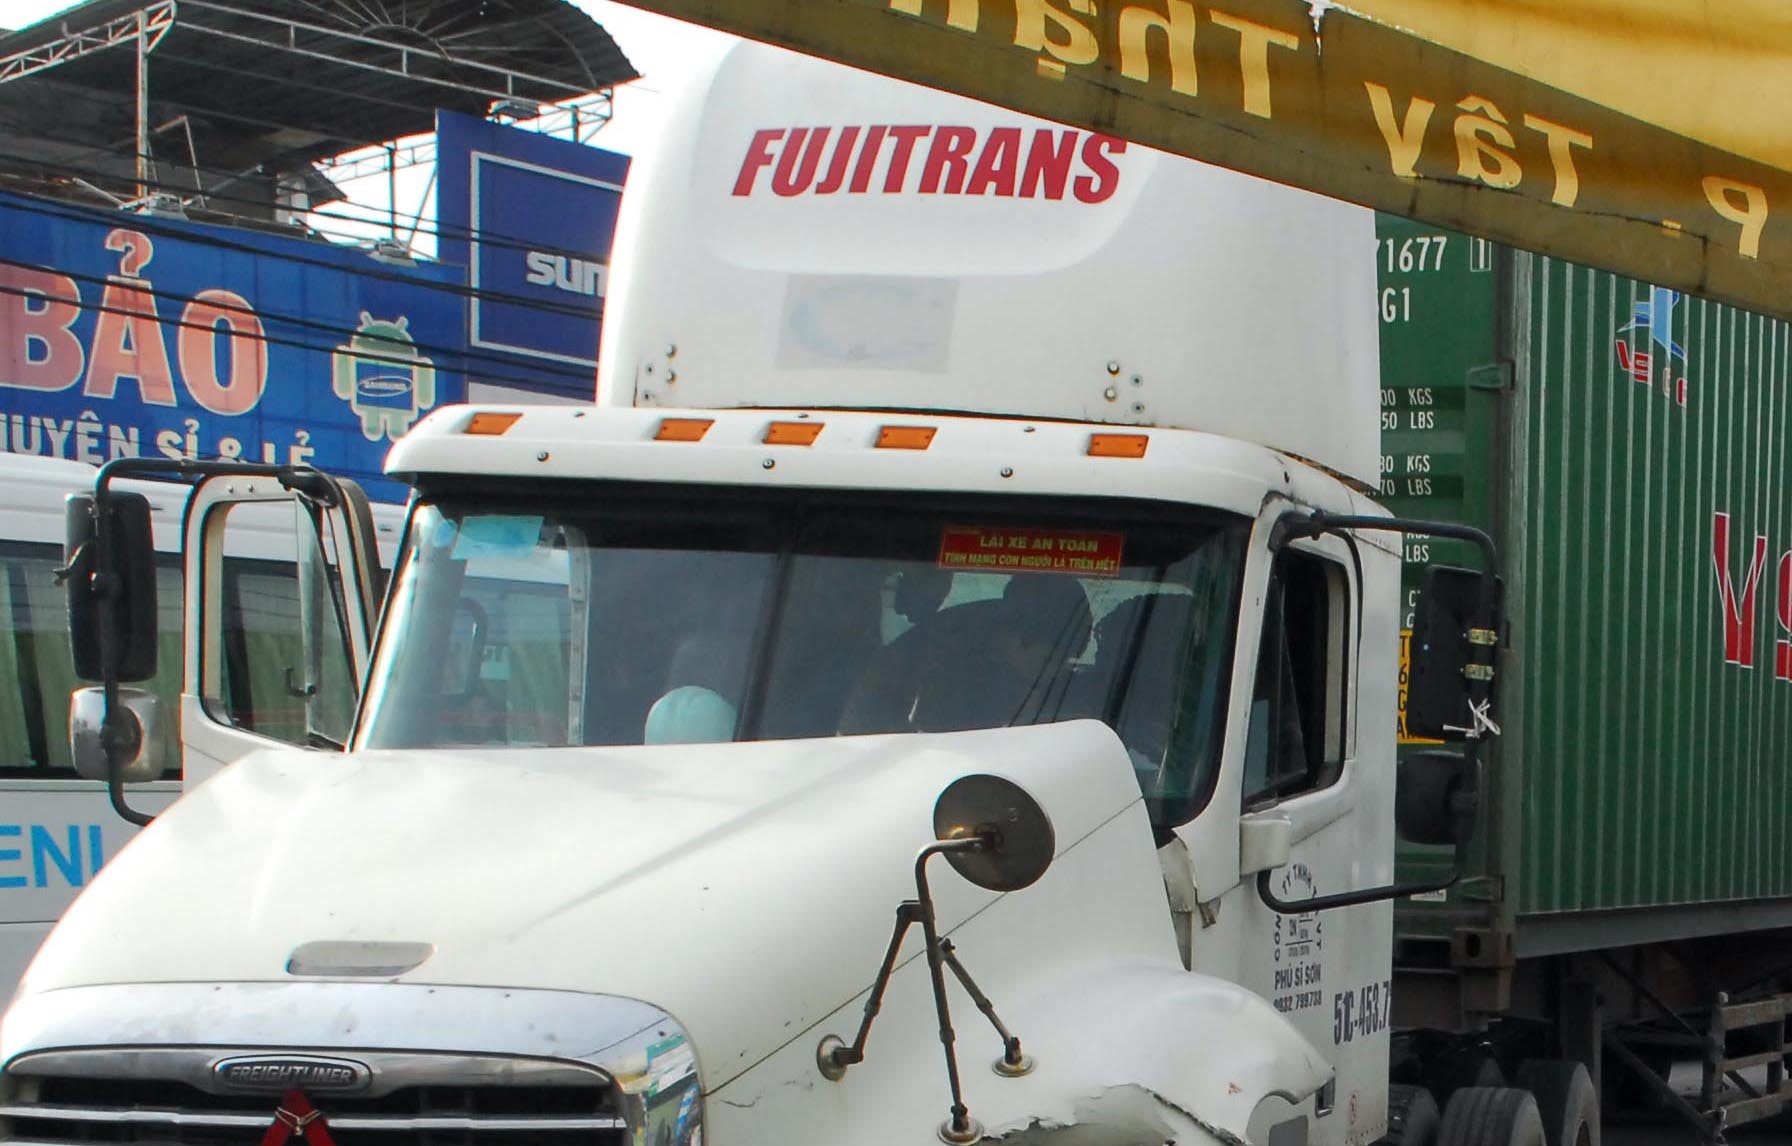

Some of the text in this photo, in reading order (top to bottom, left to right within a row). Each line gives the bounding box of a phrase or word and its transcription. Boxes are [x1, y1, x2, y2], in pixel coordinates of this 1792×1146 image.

[732, 125, 1127, 204] FUJITRANS
[1408, 388, 1433, 405] KGS
[1410, 411, 1434, 429] LBS
[1406, 454, 1430, 473] KGS
[1408, 479, 1432, 496] LBS
[1405, 544, 1430, 562] LBS
[1333, 979, 1393, 1045] 51C-453.7
[229, 1064, 354, 1083] FREIGHTLINER
